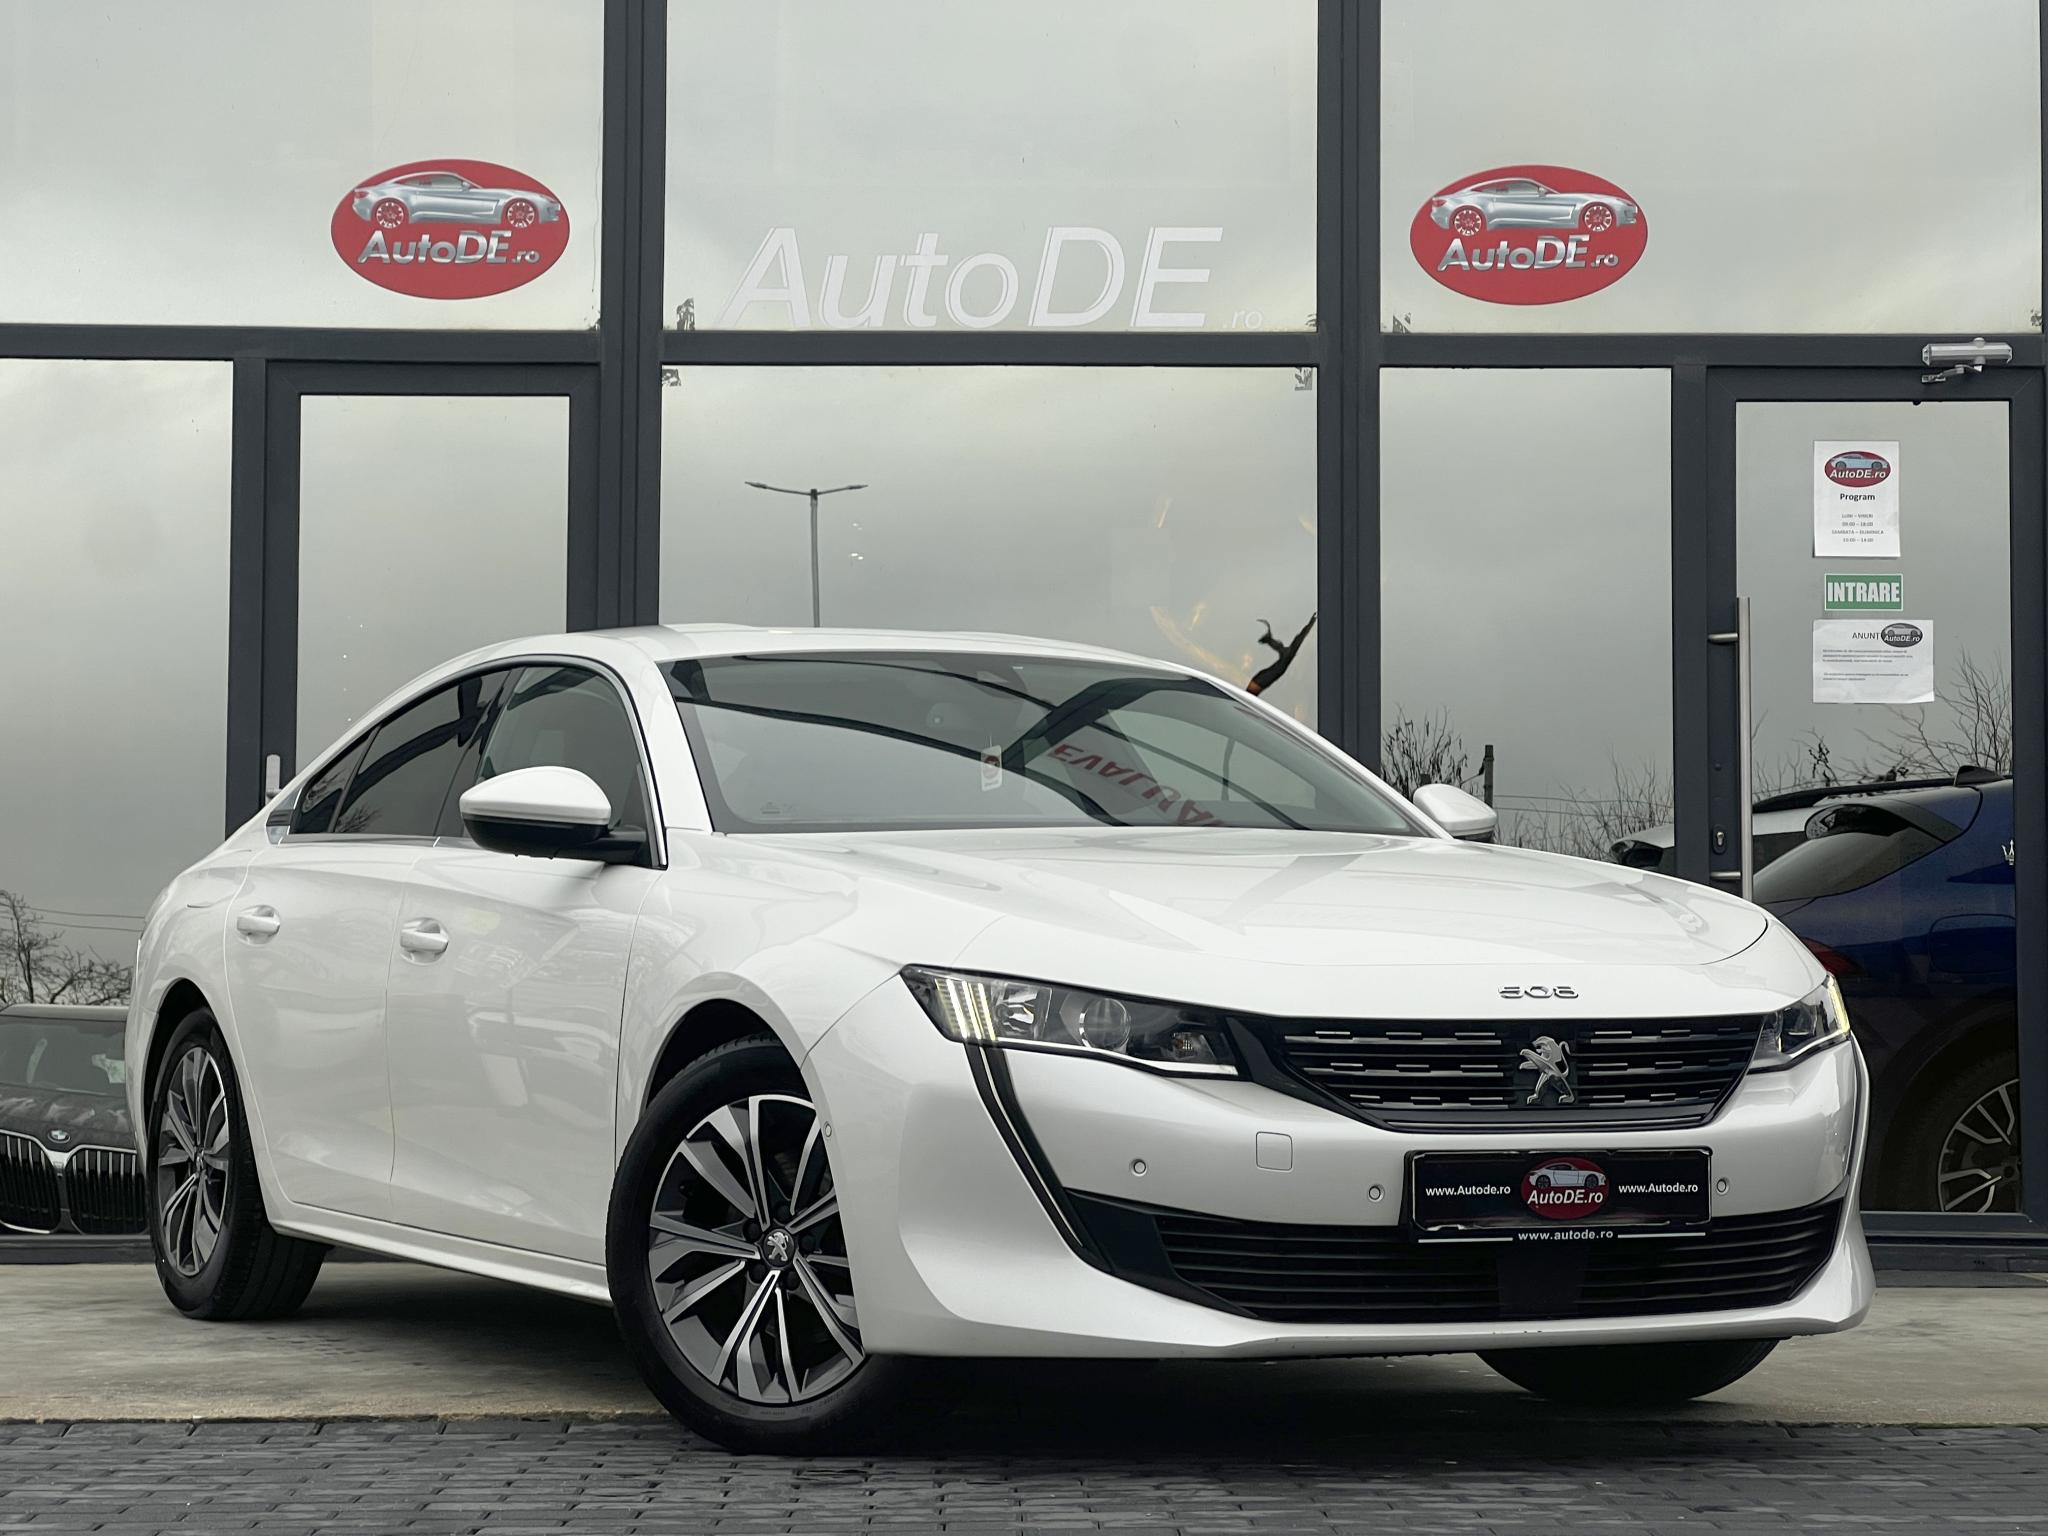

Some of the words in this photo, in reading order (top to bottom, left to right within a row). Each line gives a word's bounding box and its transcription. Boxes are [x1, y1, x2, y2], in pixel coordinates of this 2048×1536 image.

[1829, 469, 1887, 479] AutoDE.ro
[1840, 493, 1876, 502] Program
[1827, 582, 1900, 602] INTRARE
[1498, 986, 1579, 999] 508
[1425, 1184, 1511, 1196] www.Autode.ro
[1618, 1182, 1699, 1194] www.Autode.ro
[1527, 1189, 1604, 1206] AutoDE.ro
[1518, 1230, 1614, 1241] www.autode.ro
